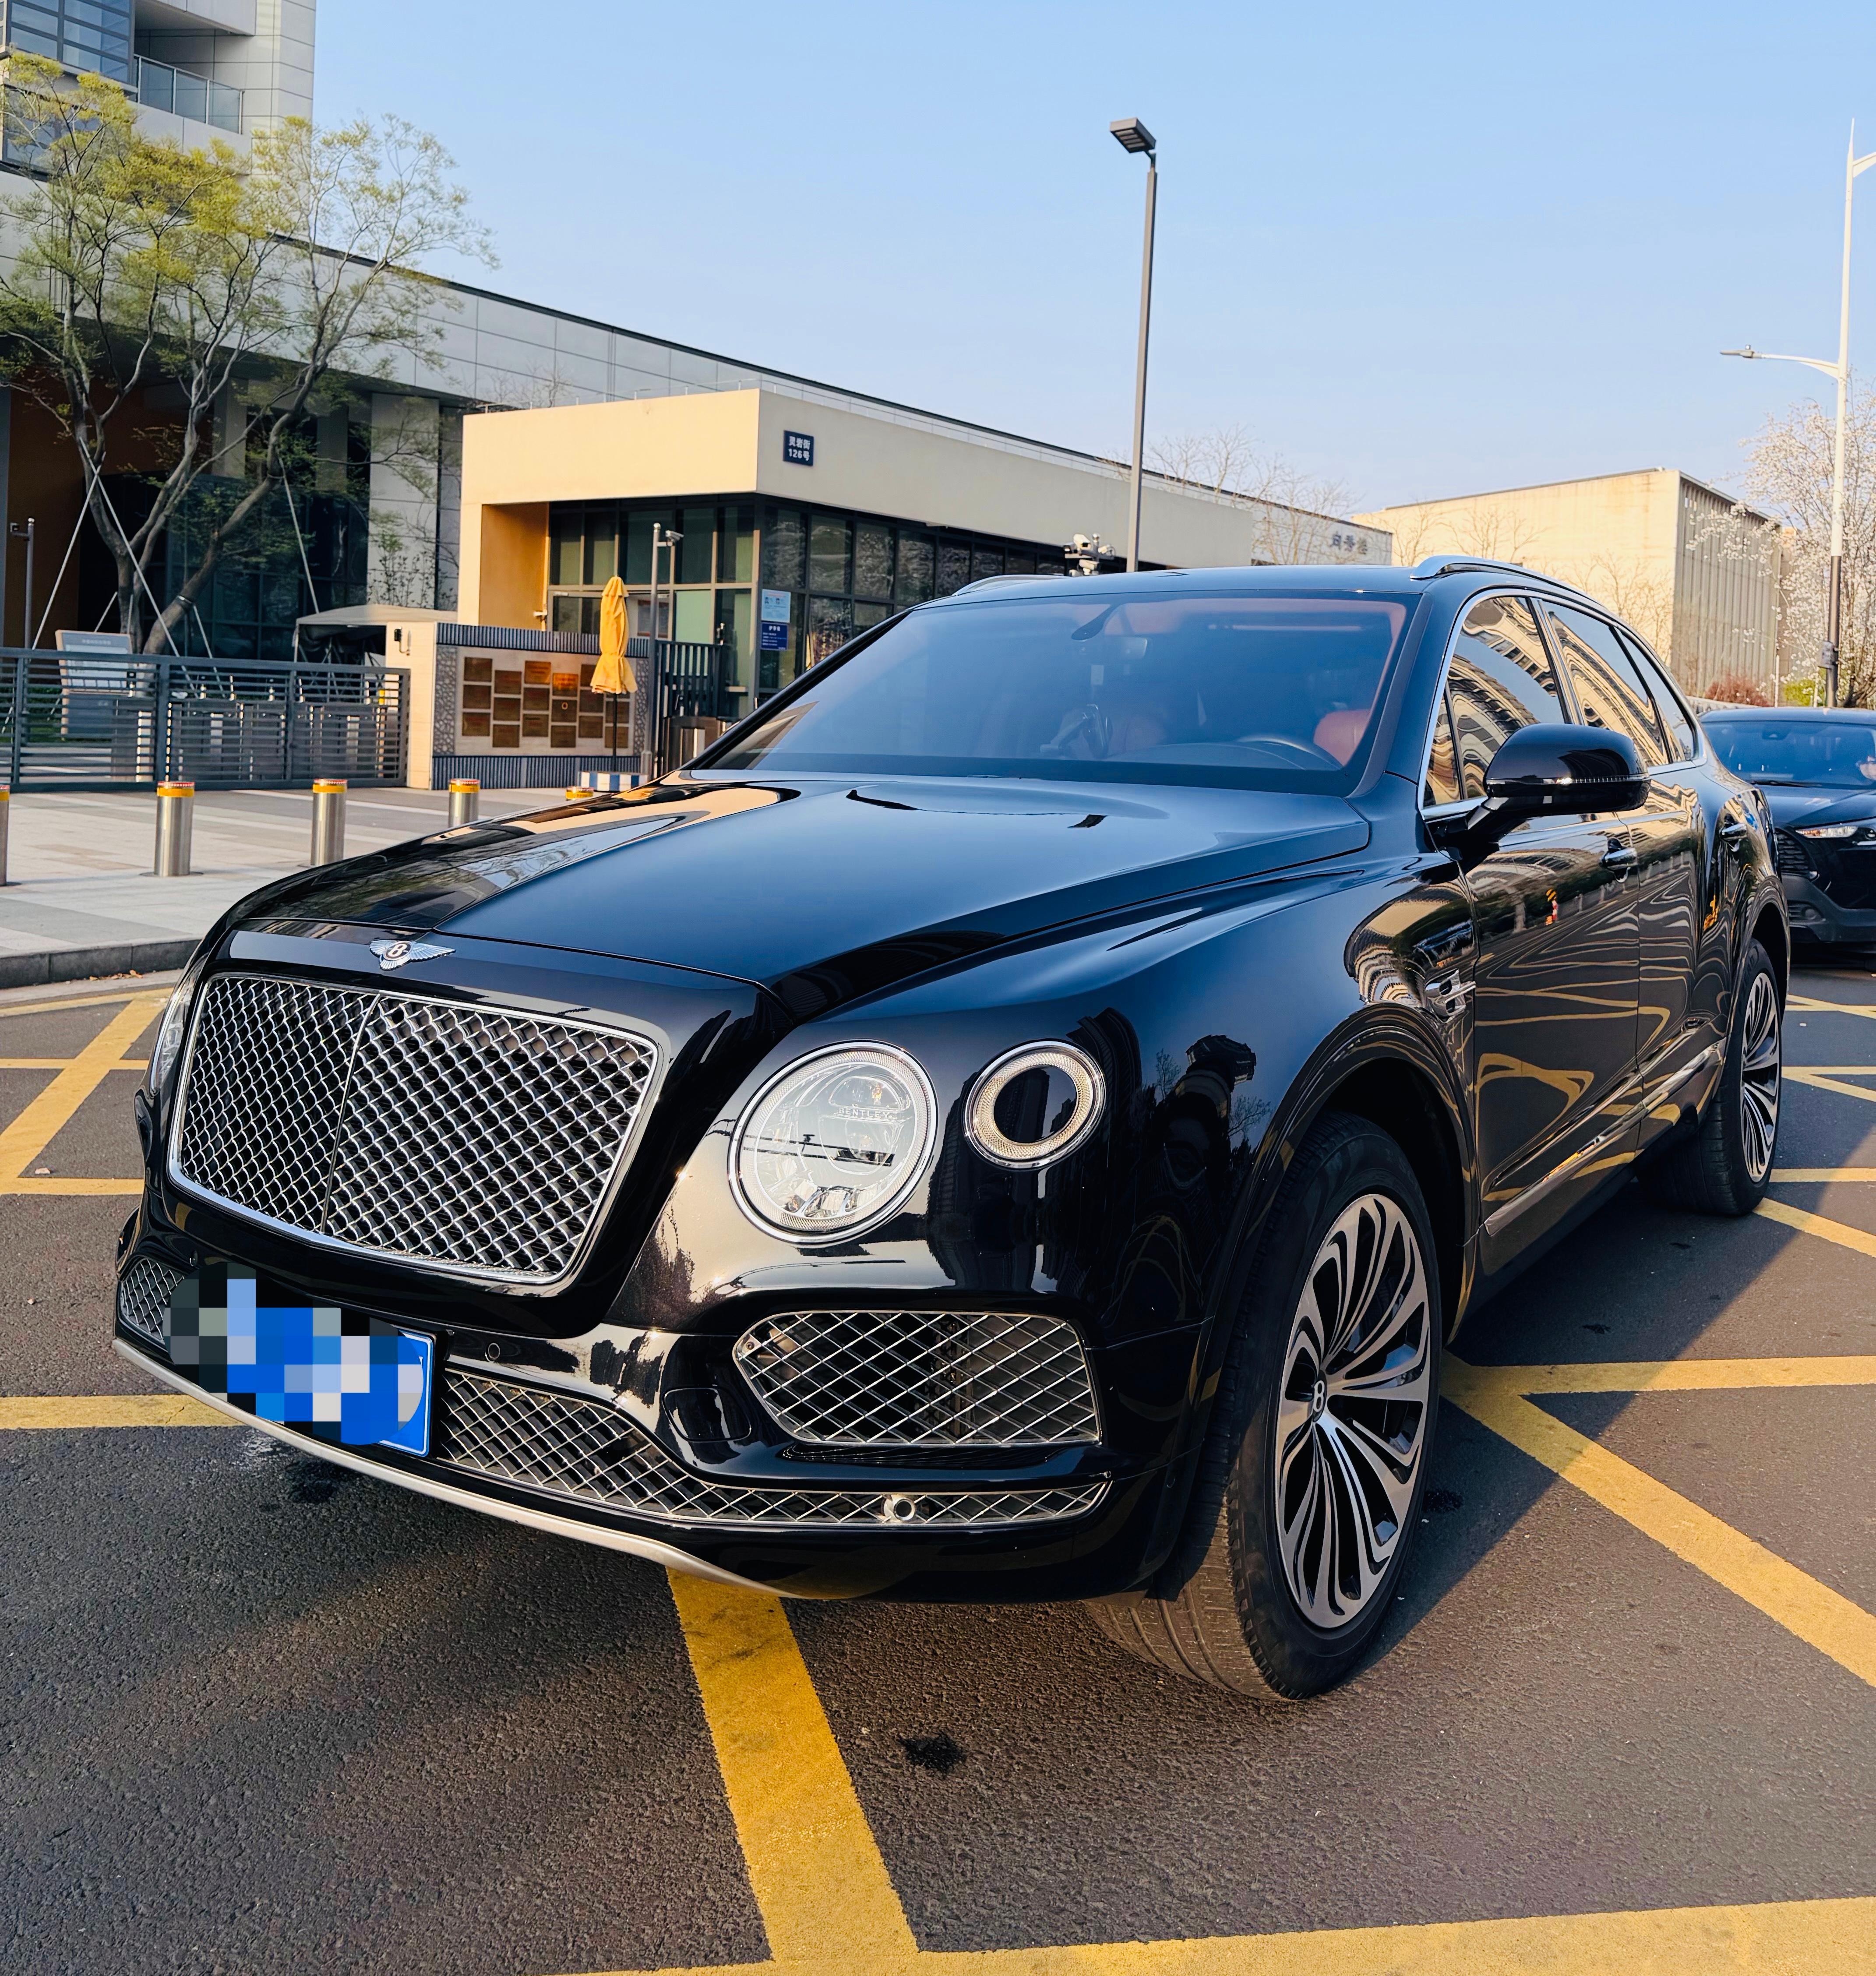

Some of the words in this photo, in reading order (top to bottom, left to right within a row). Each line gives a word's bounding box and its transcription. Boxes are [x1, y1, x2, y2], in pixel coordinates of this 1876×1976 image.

[789, 448, 810, 461] 126号
[388, 943, 408, 957] B
[839, 1107, 890, 1119] BENTLEY
[1313, 1380, 1325, 1412] B
